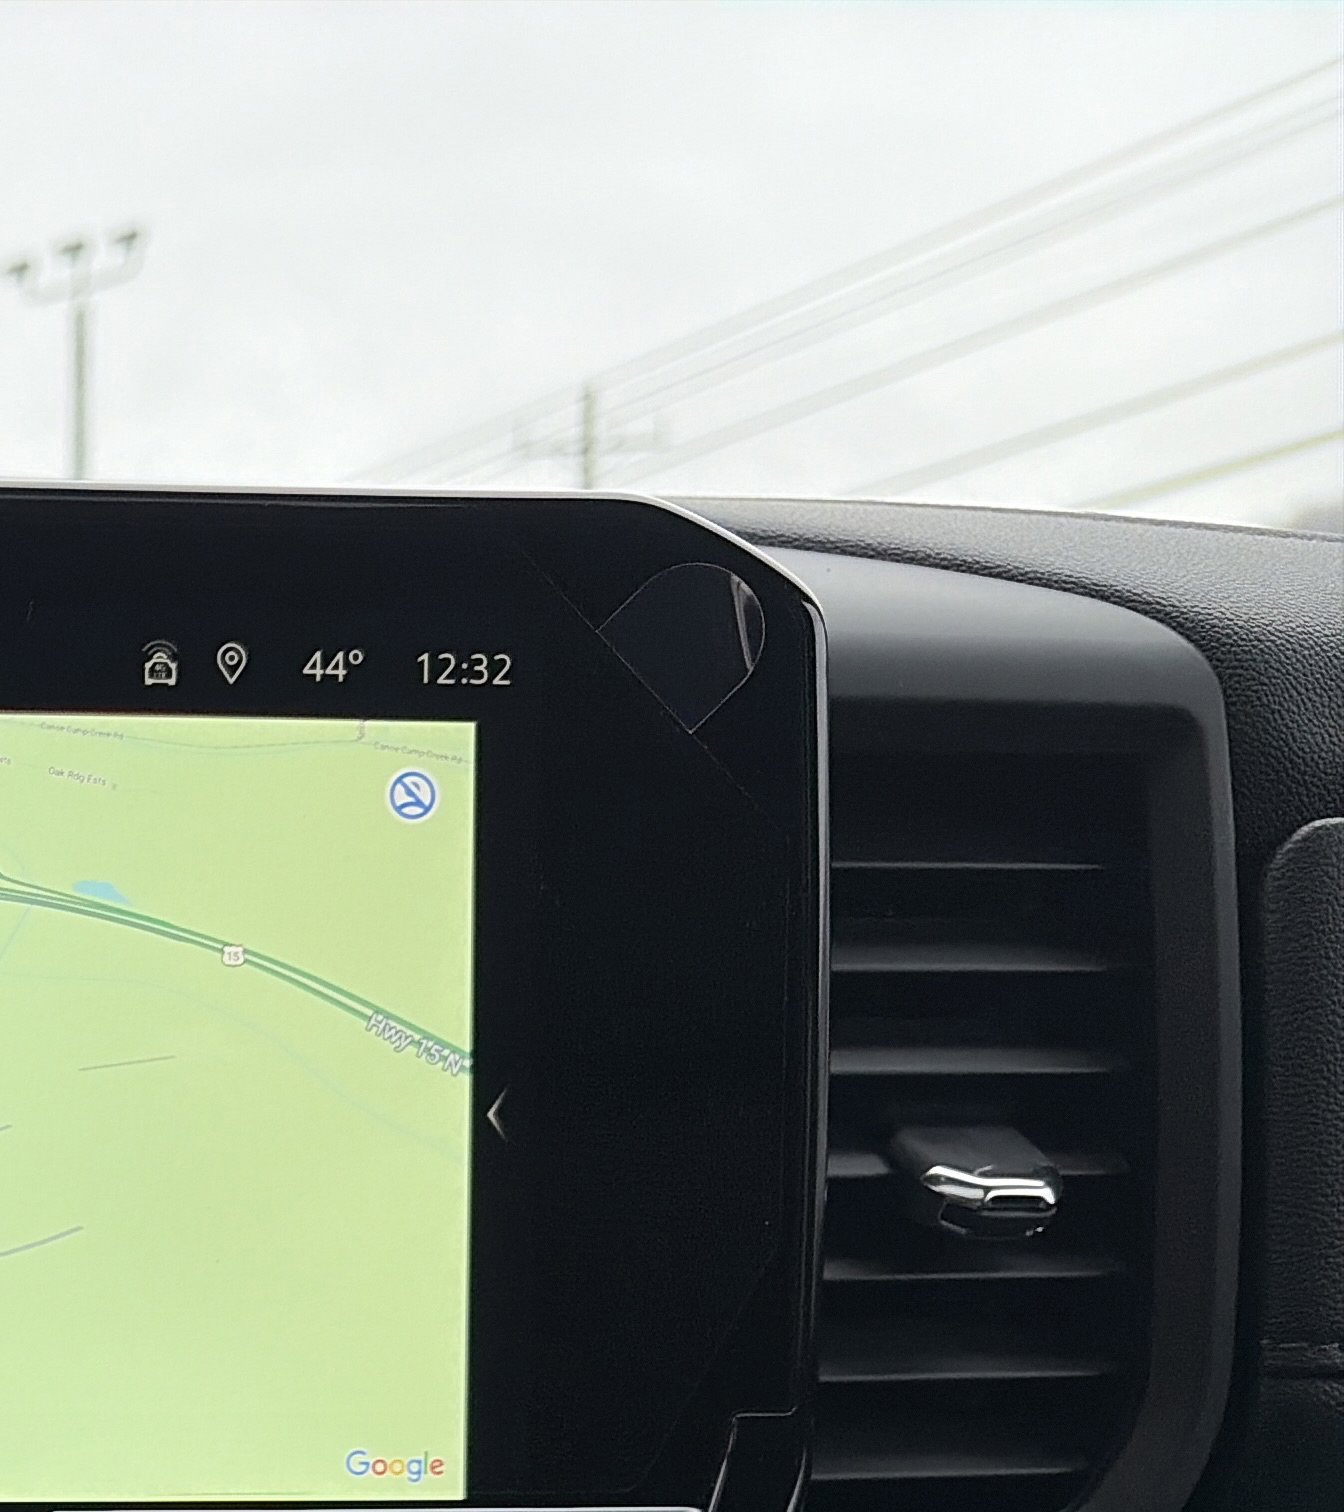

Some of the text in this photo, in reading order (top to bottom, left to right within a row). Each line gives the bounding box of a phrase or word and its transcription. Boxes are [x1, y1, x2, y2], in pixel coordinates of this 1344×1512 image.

[416, 652, 512, 685] 12:32
[49, 767, 65, 777] Oak
[67, 770, 85, 784] Rdg
[226, 951, 240, 961] 15
[365, 1012, 462, 1076] Hwy 15 N
[346, 1450, 445, 1483] Google
